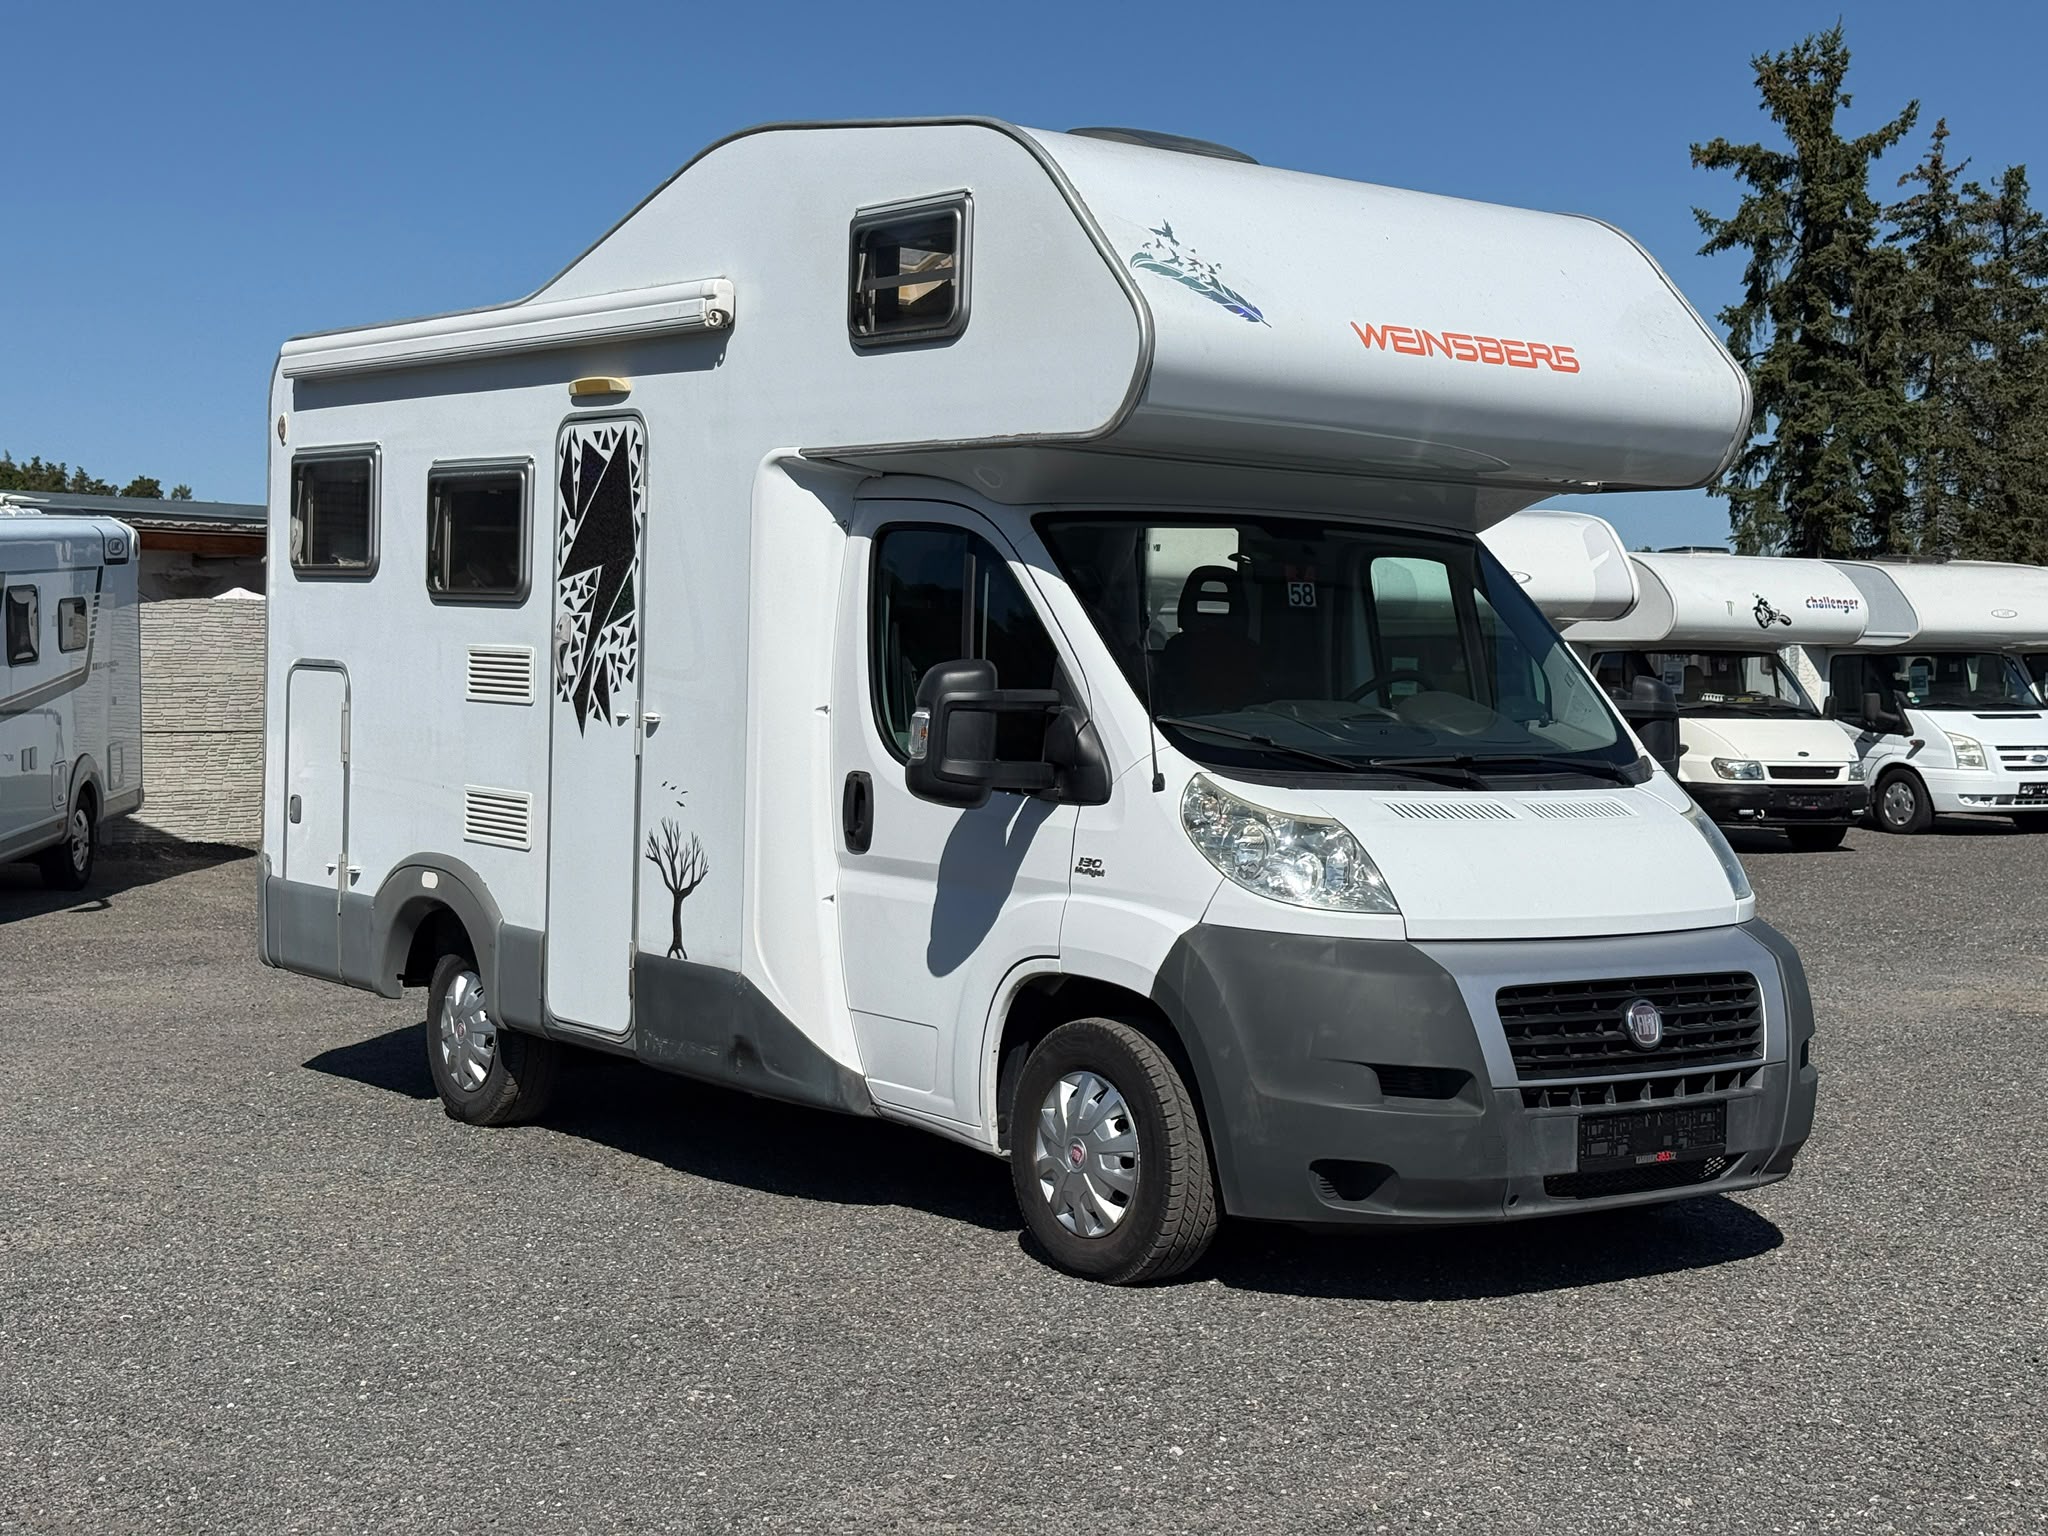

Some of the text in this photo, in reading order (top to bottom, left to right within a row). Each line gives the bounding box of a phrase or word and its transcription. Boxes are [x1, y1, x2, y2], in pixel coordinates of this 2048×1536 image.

[1350, 320, 1580, 373] WEINSBERG
[1290, 583, 1314, 606] 58
[1805, 596, 1859, 614] challenger
[1078, 857, 1102, 868] 130
